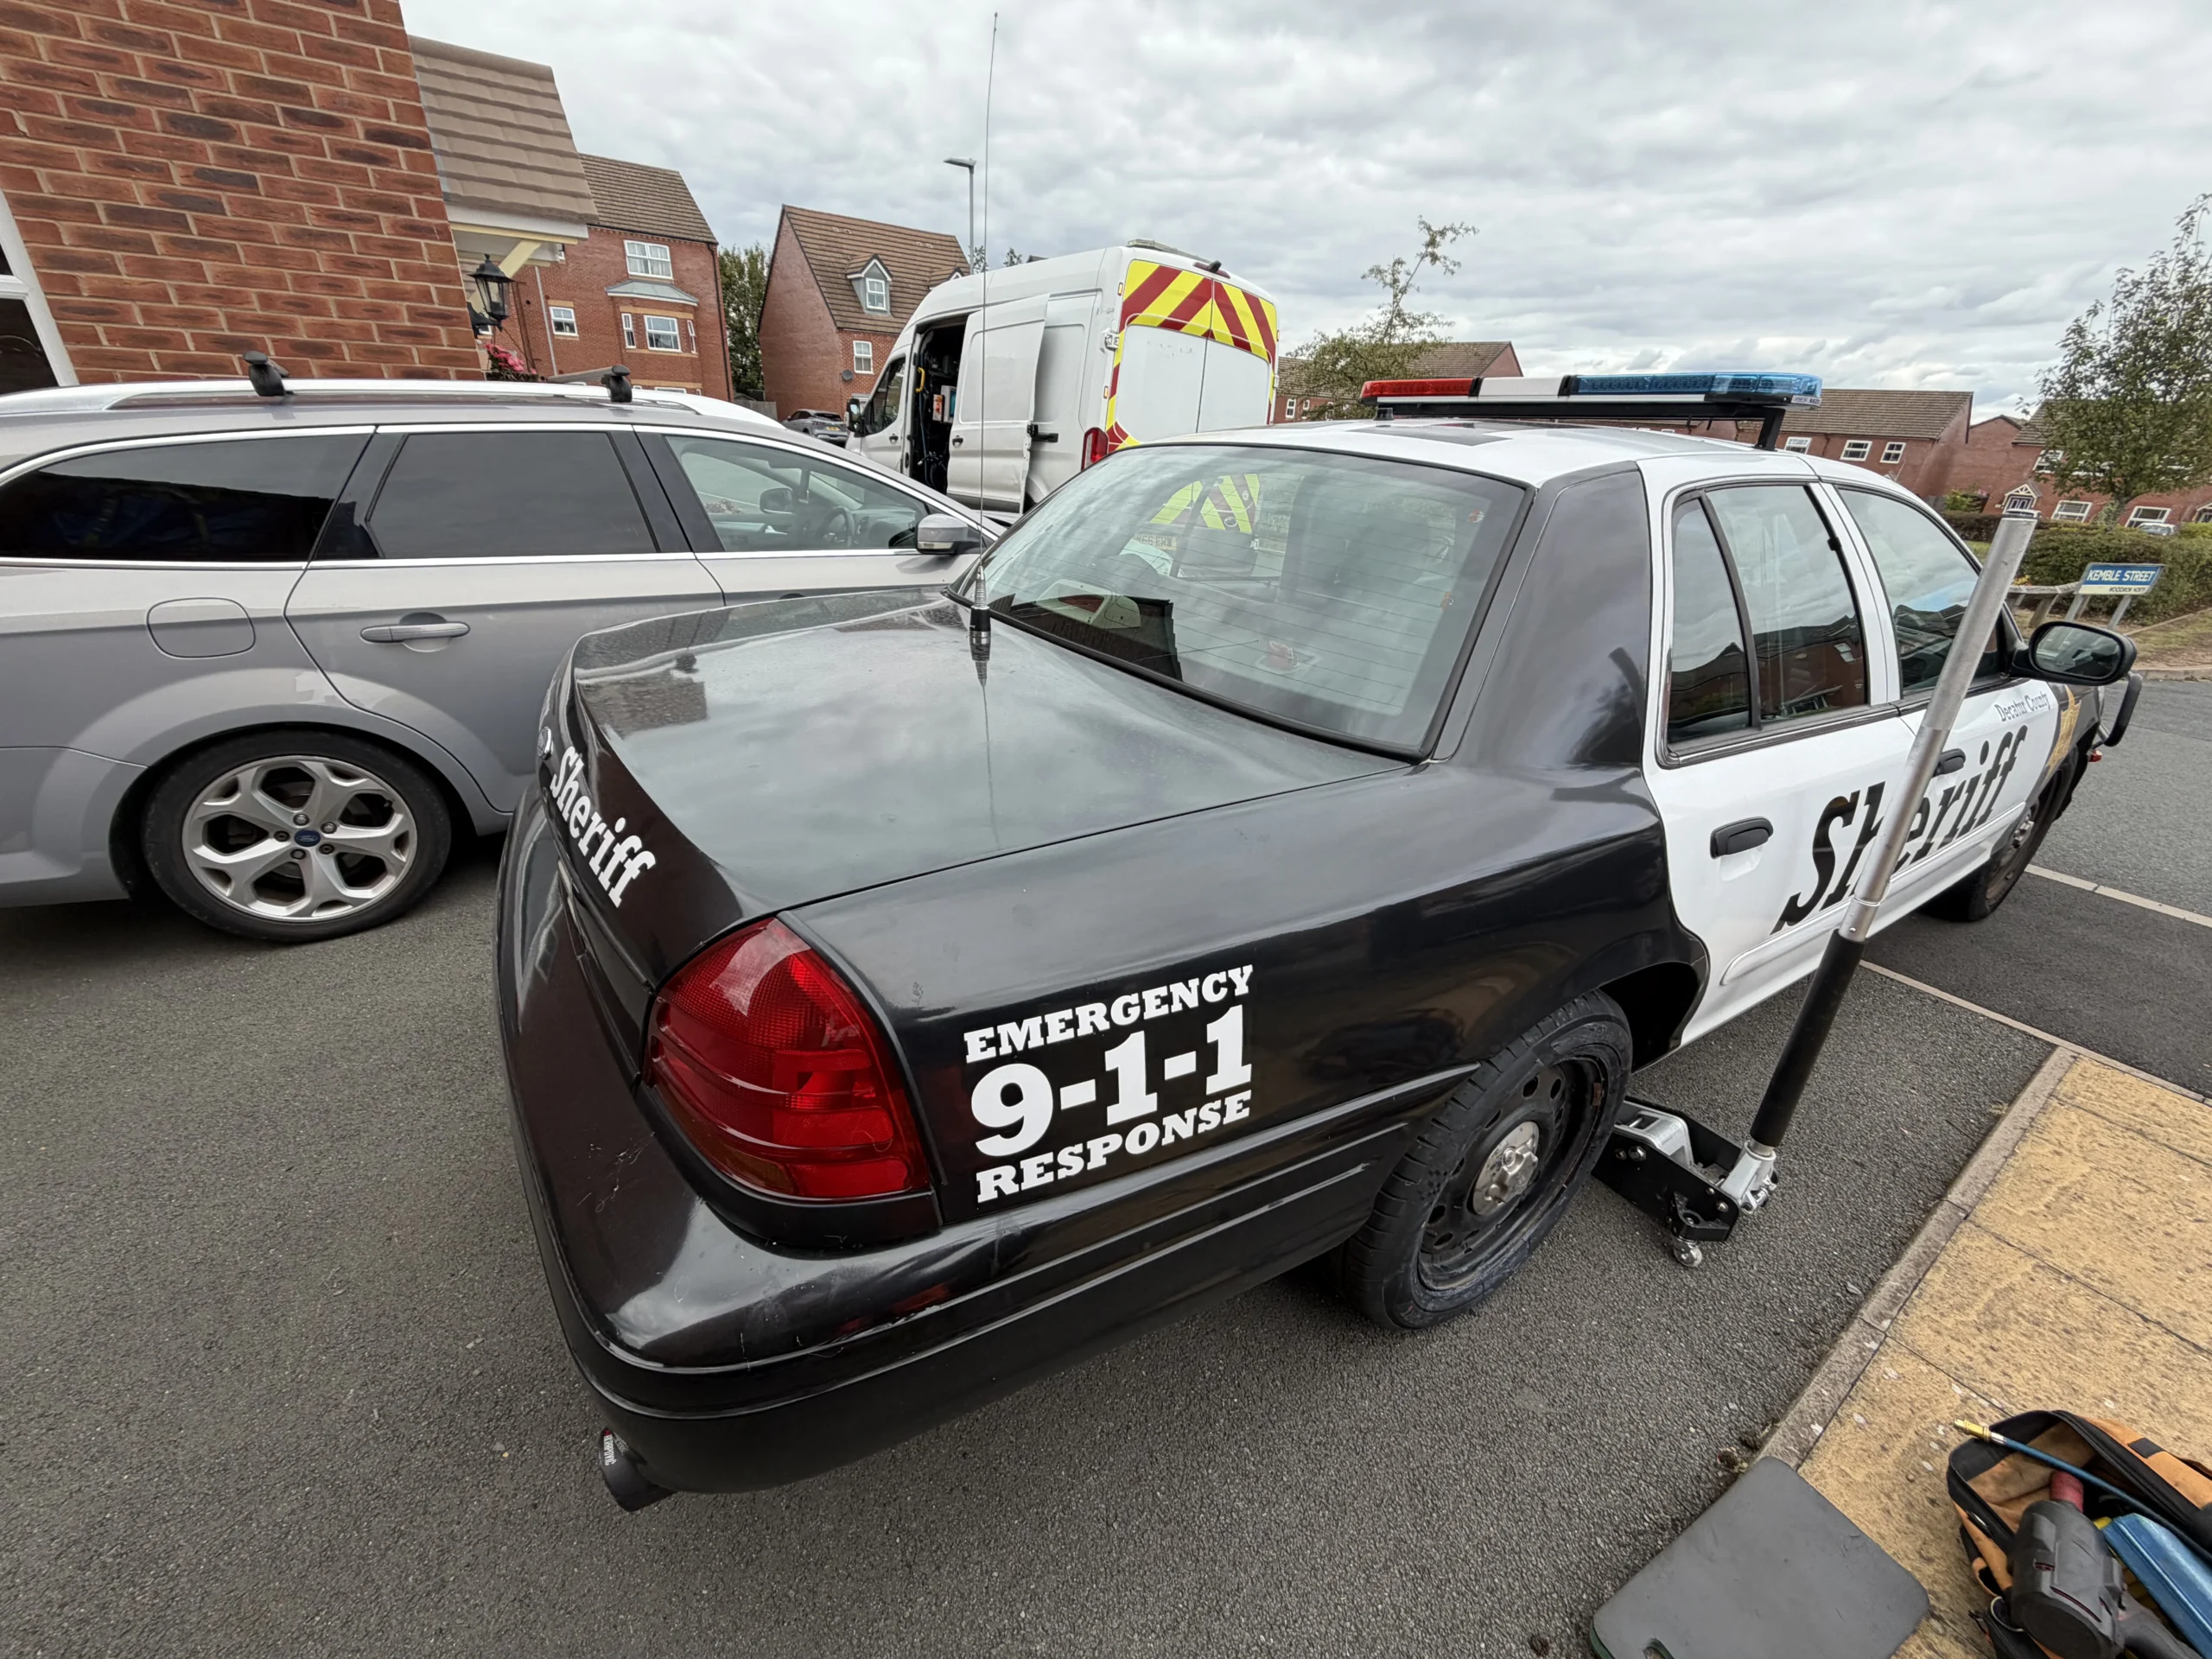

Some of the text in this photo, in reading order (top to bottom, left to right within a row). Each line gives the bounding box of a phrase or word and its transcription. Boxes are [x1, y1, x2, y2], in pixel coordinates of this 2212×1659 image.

[2087, 569, 2156, 582] KEMBLE STREET
[1994, 690, 2050, 722] Decatur County
[550, 746, 656, 908] Sheriff
[963, 964, 1254, 1064] EMERGENCY
[970, 1004, 1252, 1157] 9-1-1
[976, 1089, 1252, 1204] RESPONSE
